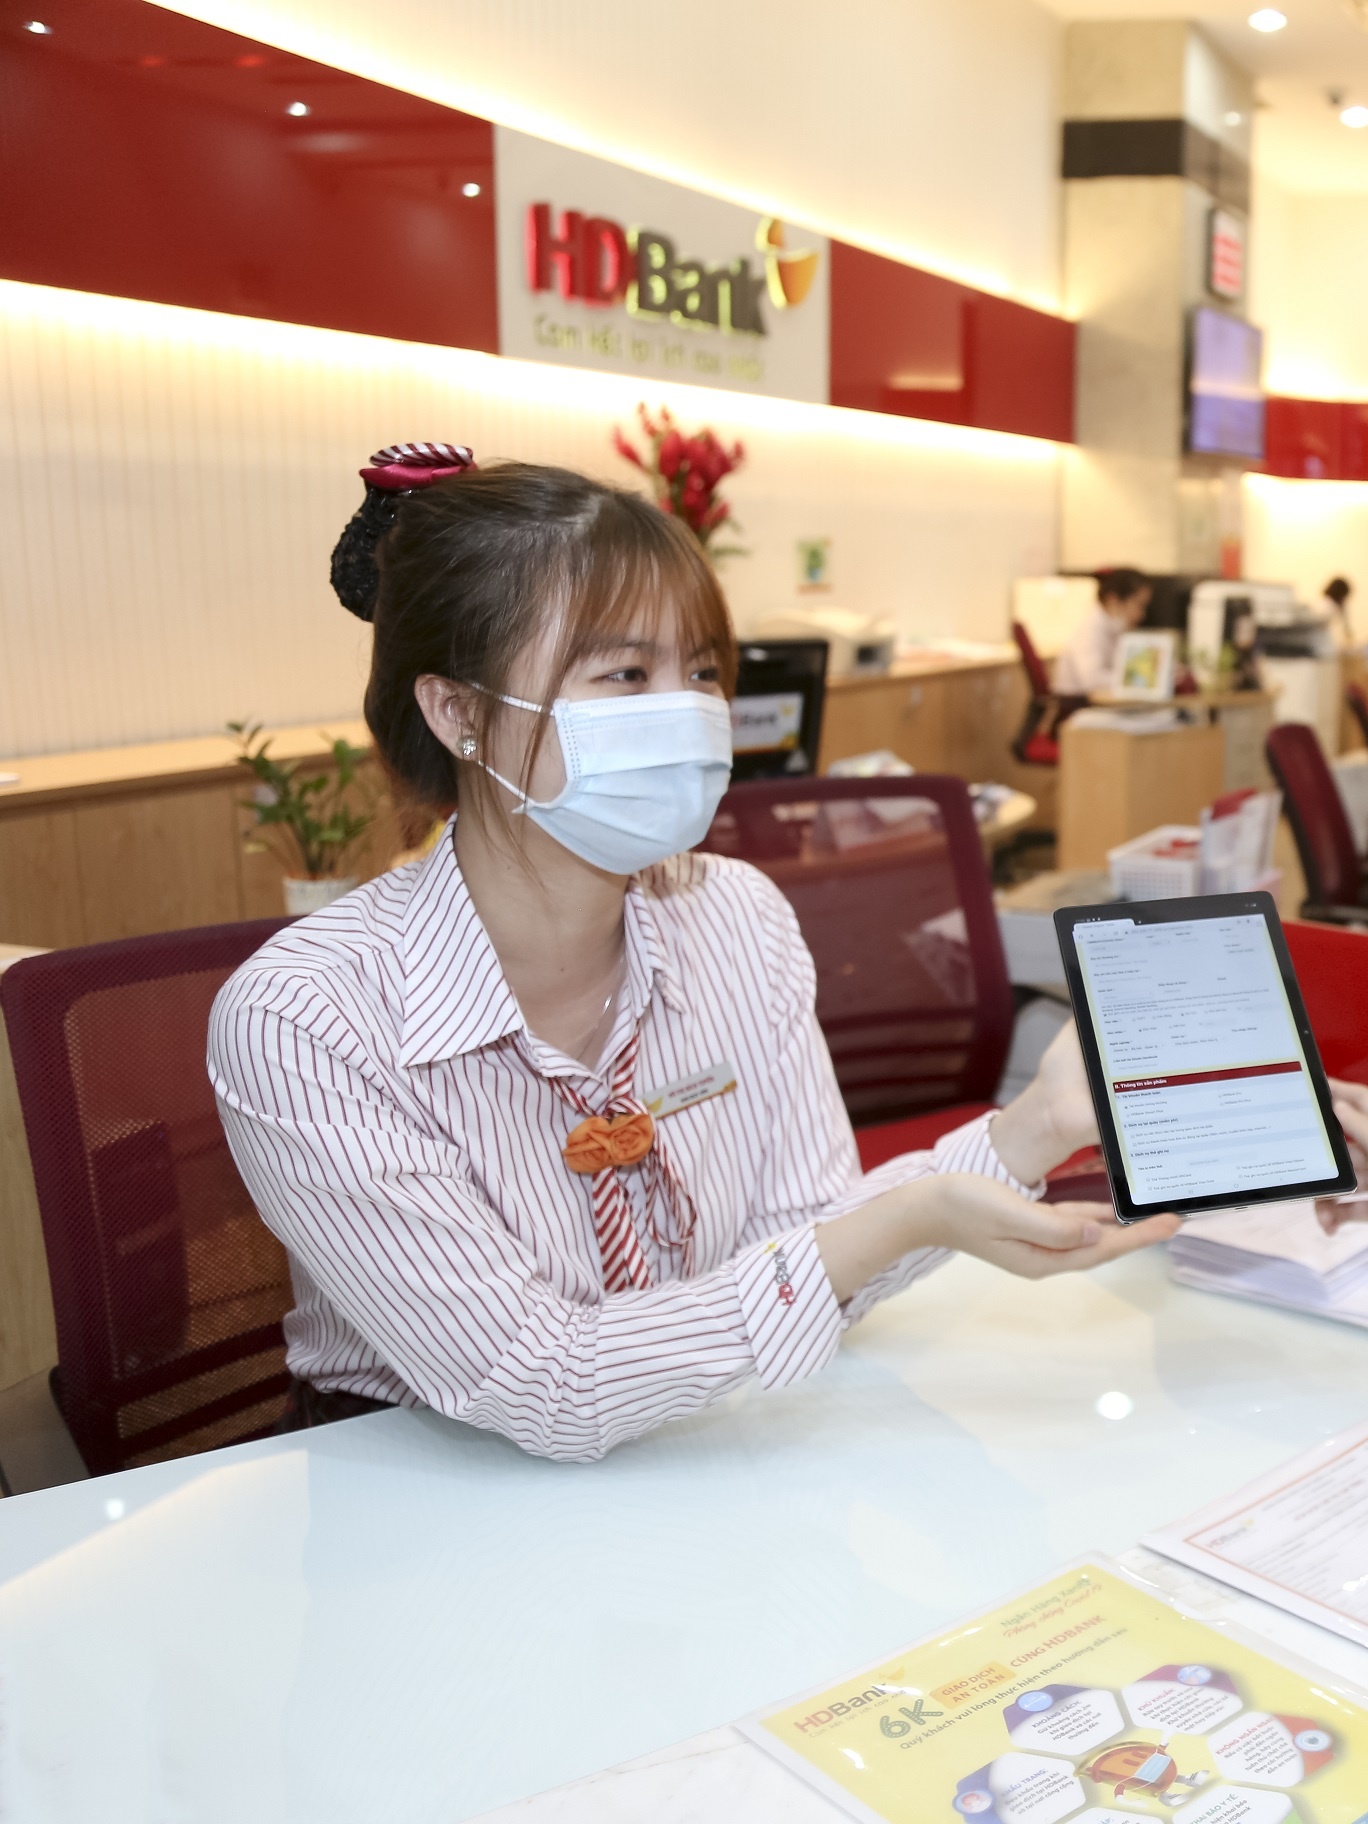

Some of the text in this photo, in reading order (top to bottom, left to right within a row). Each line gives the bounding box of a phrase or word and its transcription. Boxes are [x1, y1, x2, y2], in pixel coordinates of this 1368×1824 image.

[526, 202, 769, 338] HDBank
[1010, 1615, 1105, 1667] CÙNG HDBANK
[941, 1667, 995, 1696] GIAO DỊCH
[952, 1674, 1005, 1702] AN TOÀN
[879, 1699, 944, 1738] 6K
[900, 1735, 922, 1749] Quý
[921, 1719, 956, 1738] khách
[954, 1709, 973, 1720] vui
[970, 1698, 997, 1711] lòng
[994, 1686, 1019, 1699] thực
[1016, 1675, 1040, 1688] hiện
[1039, 1662, 1062, 1675] theo
[1044, 1775, 1068, 1789] HDBank
